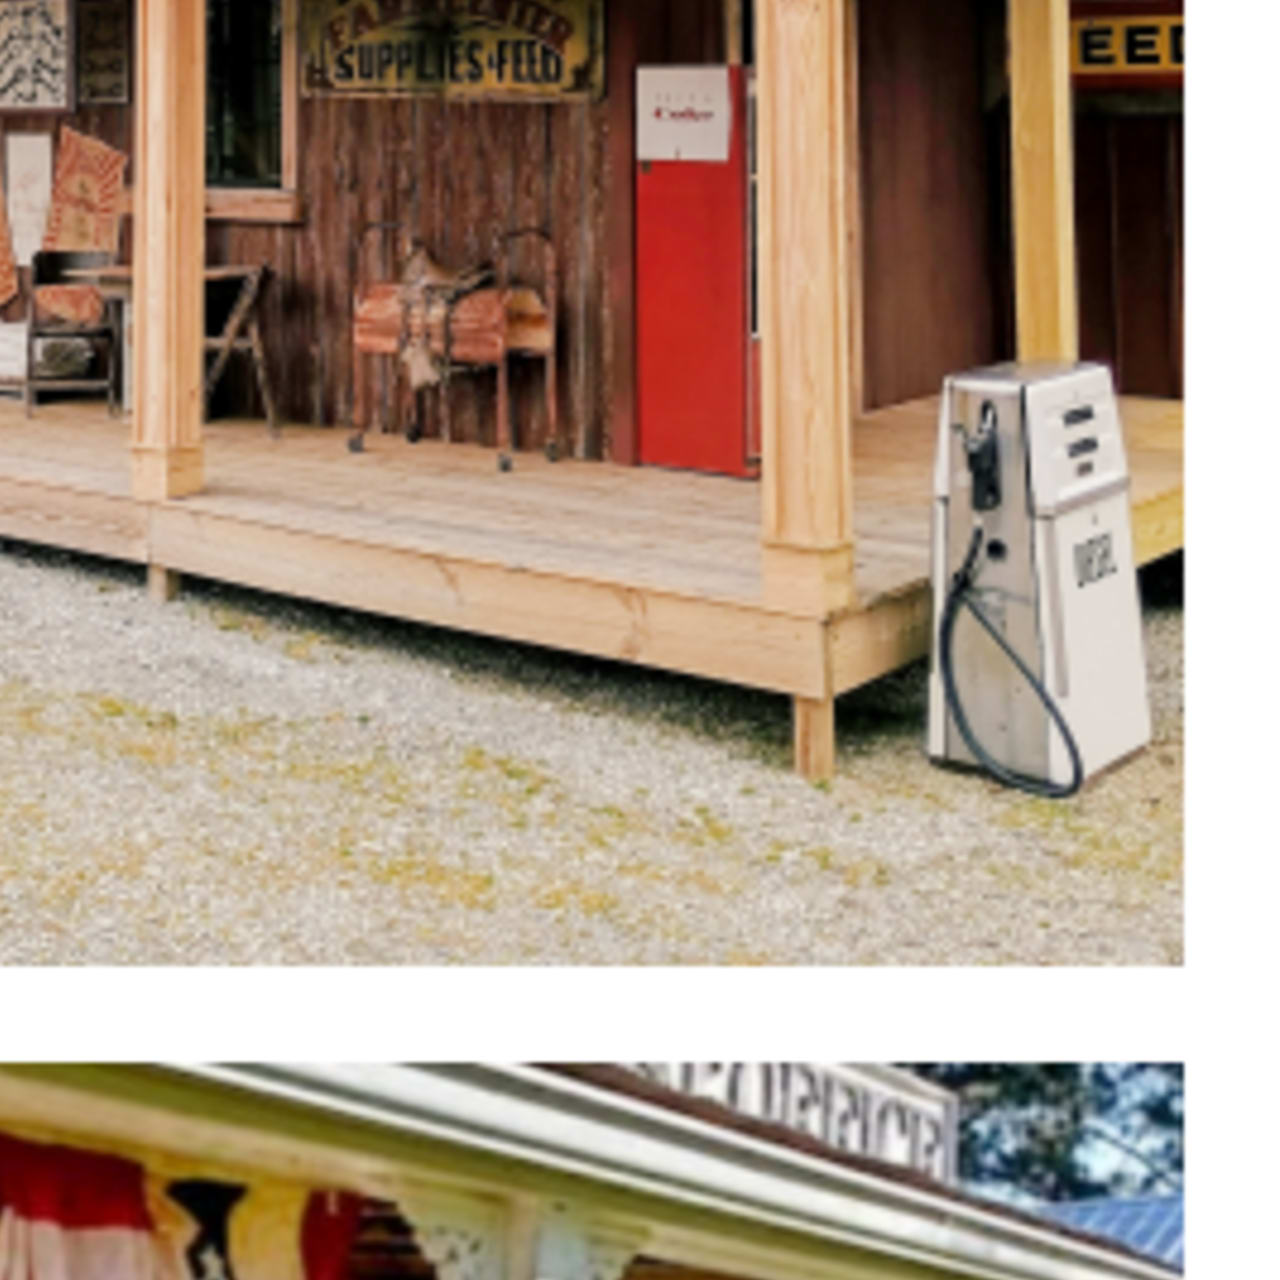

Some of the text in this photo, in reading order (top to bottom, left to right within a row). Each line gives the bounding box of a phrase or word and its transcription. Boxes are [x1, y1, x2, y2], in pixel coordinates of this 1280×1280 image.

[334, 40, 483, 84] SUPPLIES
[497, 38, 564, 84] FEED
[1080, 25, 1184, 66] EE
